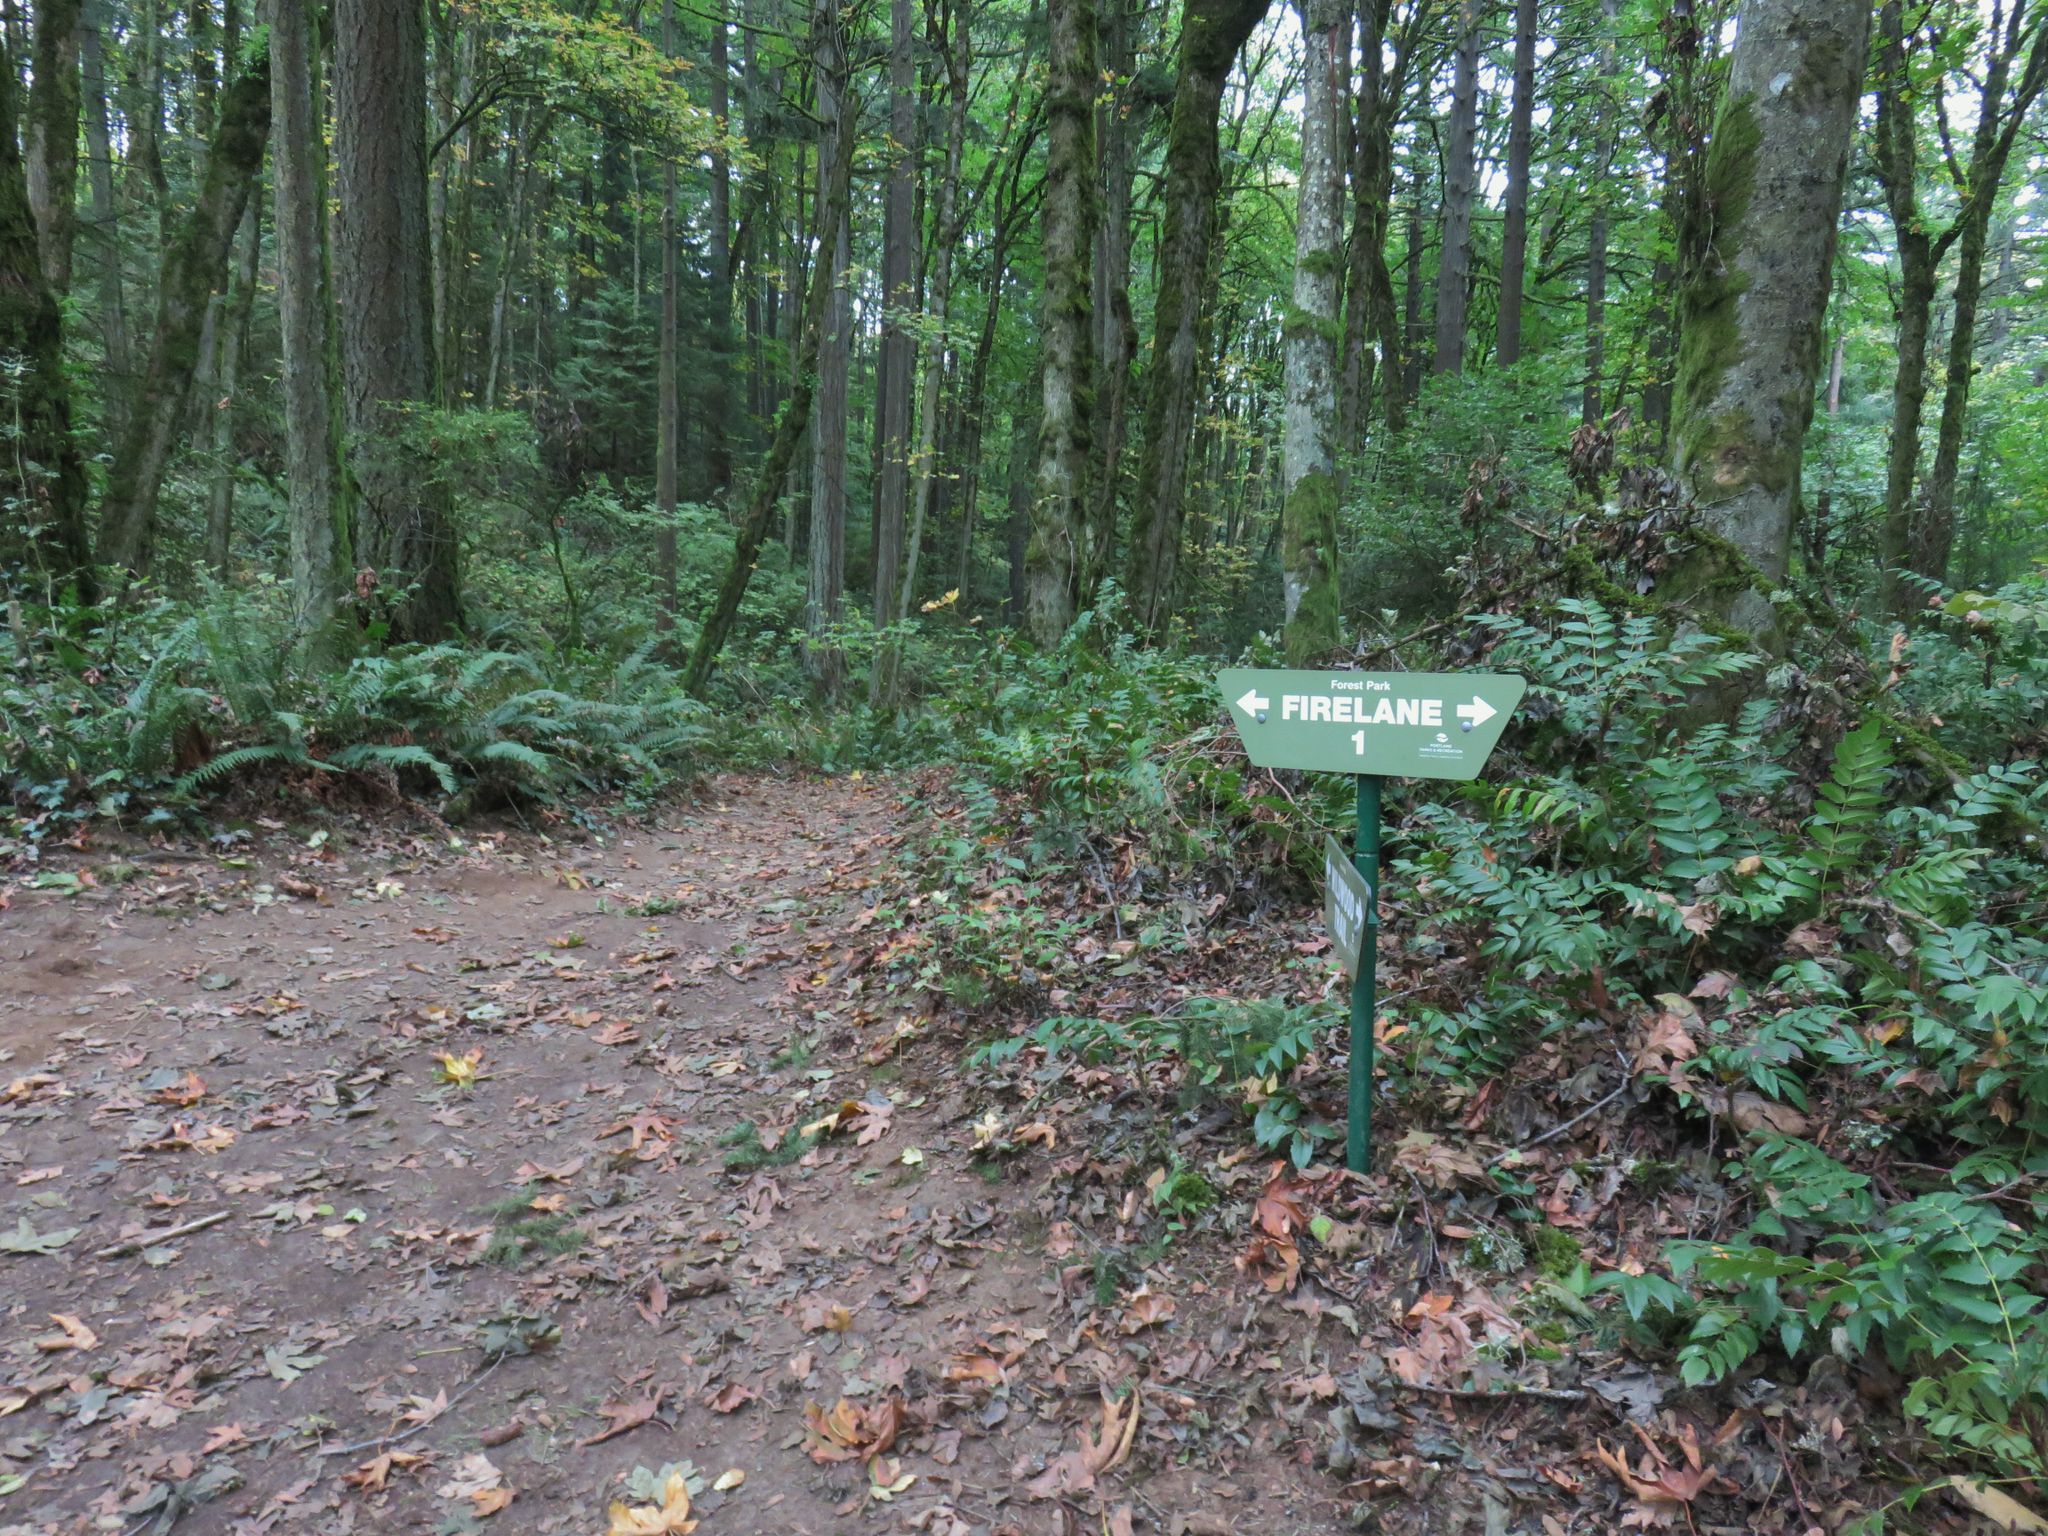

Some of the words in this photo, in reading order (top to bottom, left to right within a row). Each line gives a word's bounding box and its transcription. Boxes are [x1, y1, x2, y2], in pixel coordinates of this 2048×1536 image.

[1331, 680, 1364, 691] Forest
[1366, 681, 1391, 692] Park
[1282, 695, 1443, 727] FIRELANE
[1351, 730, 1365, 755] 1
